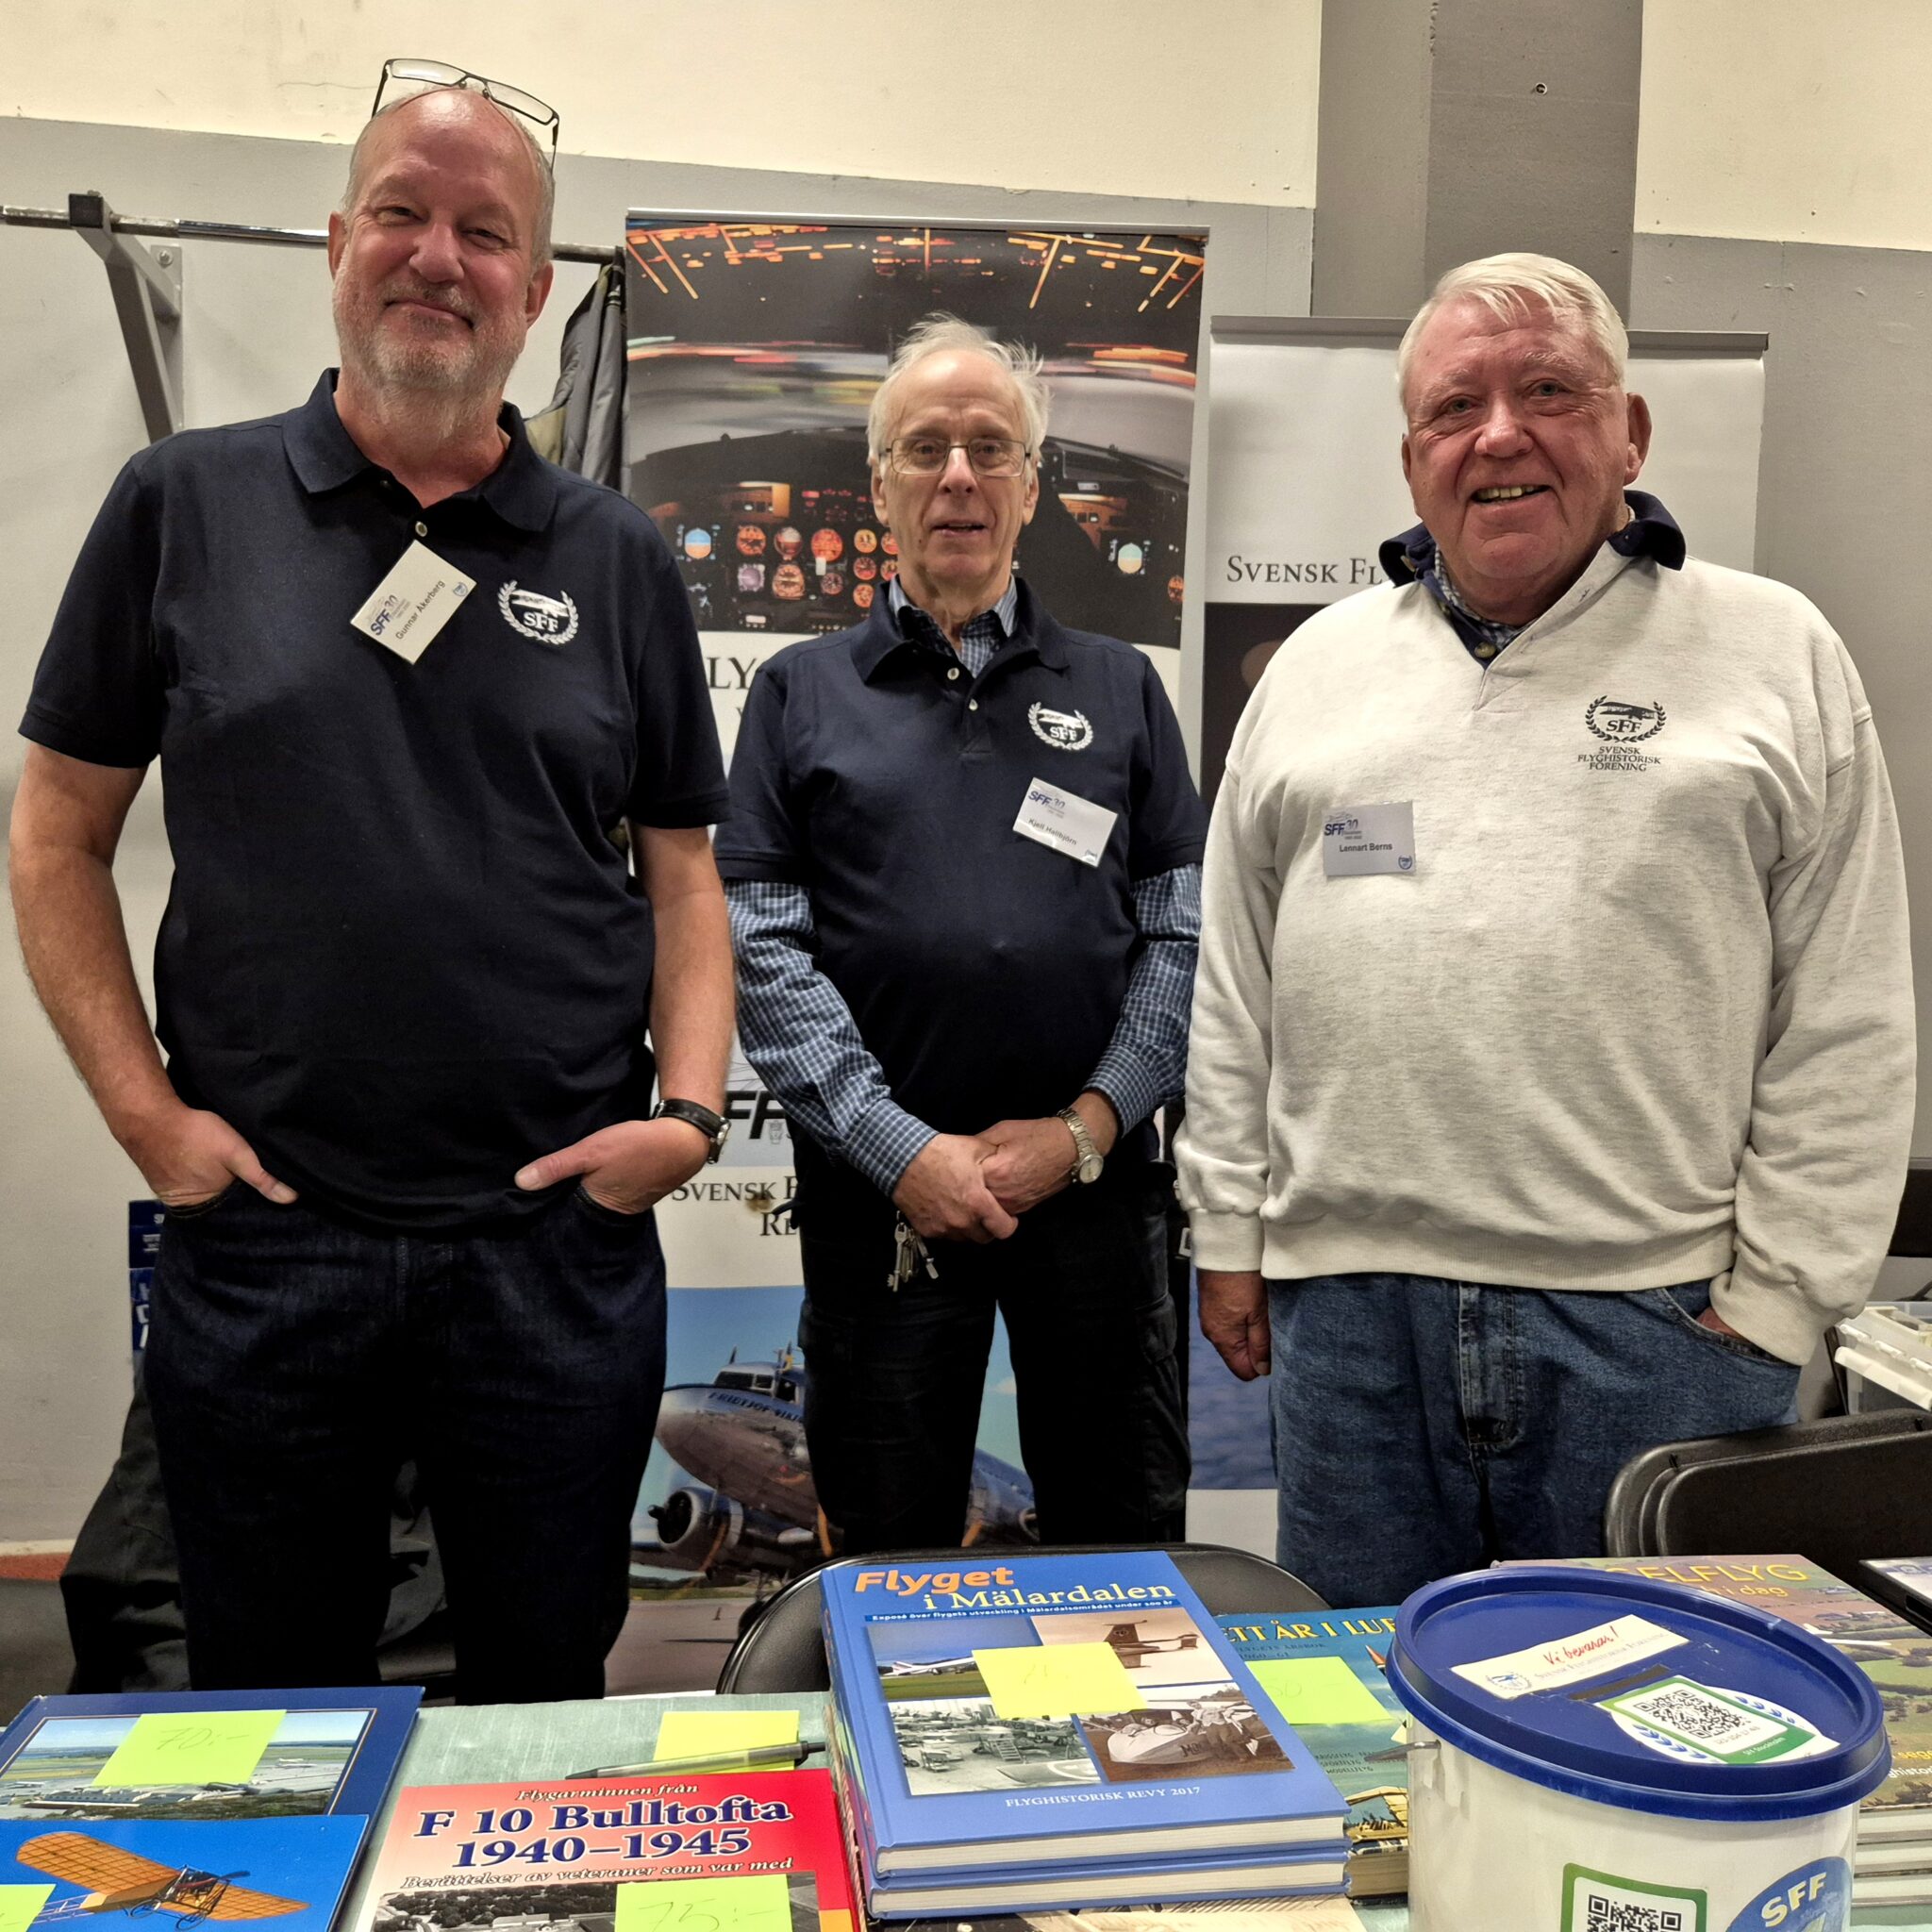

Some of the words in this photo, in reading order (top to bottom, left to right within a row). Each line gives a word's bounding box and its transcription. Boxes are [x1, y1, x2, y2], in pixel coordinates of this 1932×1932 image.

[1226, 556, 1339, 583] SVENSK
[1349, 558, 1383, 585] FL
[370, 608, 391, 637] SFF
[395, 612, 418, 640] Gunnar
[524, 611, 559, 633] SFF
[706, 657, 757, 690] LY
[1049, 725, 1078, 742] SFF
[1606, 719, 1642, 733] SFF
[1577, 754, 1661, 765] FLYGHISTORISK
[1599, 745, 1641, 755] SVENSK
[1028, 791, 1053, 807] SFF
[1324, 823, 1346, 836] SFF
[1340, 843, 1368, 853] Lennart
[1369, 842, 1393, 851] Berns
[672, 1181, 776, 1202] SVENSK
[759, 1211, 797, 1237] RE
[855, 1567, 1014, 1596] Flyget
[1738, 1584, 1790, 1598] dag
[923, 1592, 938, 1610] i
[949, 1583, 1176, 1608] Mälardalen
[932, 1610, 968, 1619] flygets
[968, 1607, 1021, 1616] utveckling
[1270, 1619, 1319, 1640] ÅR
[1320, 1621, 1338, 1637] I
[1341, 1617, 1396, 1636] LUF
[518, 1786, 653, 1803] Flygarminnen
[656, 1782, 699, 1798] från
[1005, 1790, 1124, 1808] FLYGHISTORISK
[1126, 1789, 1167, 1800] REVY
[1170, 1786, 1202, 1797] 2017
[413, 1809, 456, 1838] F
[471, 1807, 534, 1835] 10
[547, 1794, 792, 1831] Bulltofta
[400, 1871, 523, 1890] Berättelser
[524, 1871, 554, 1883] av
[557, 1865, 658, 1882] veteraner
[659, 1862, 706, 1876] som
[708, 1861, 745, 1874] var
[748, 1857, 794, 1872] med
[1761, 1872, 1828, 1928] SFF
